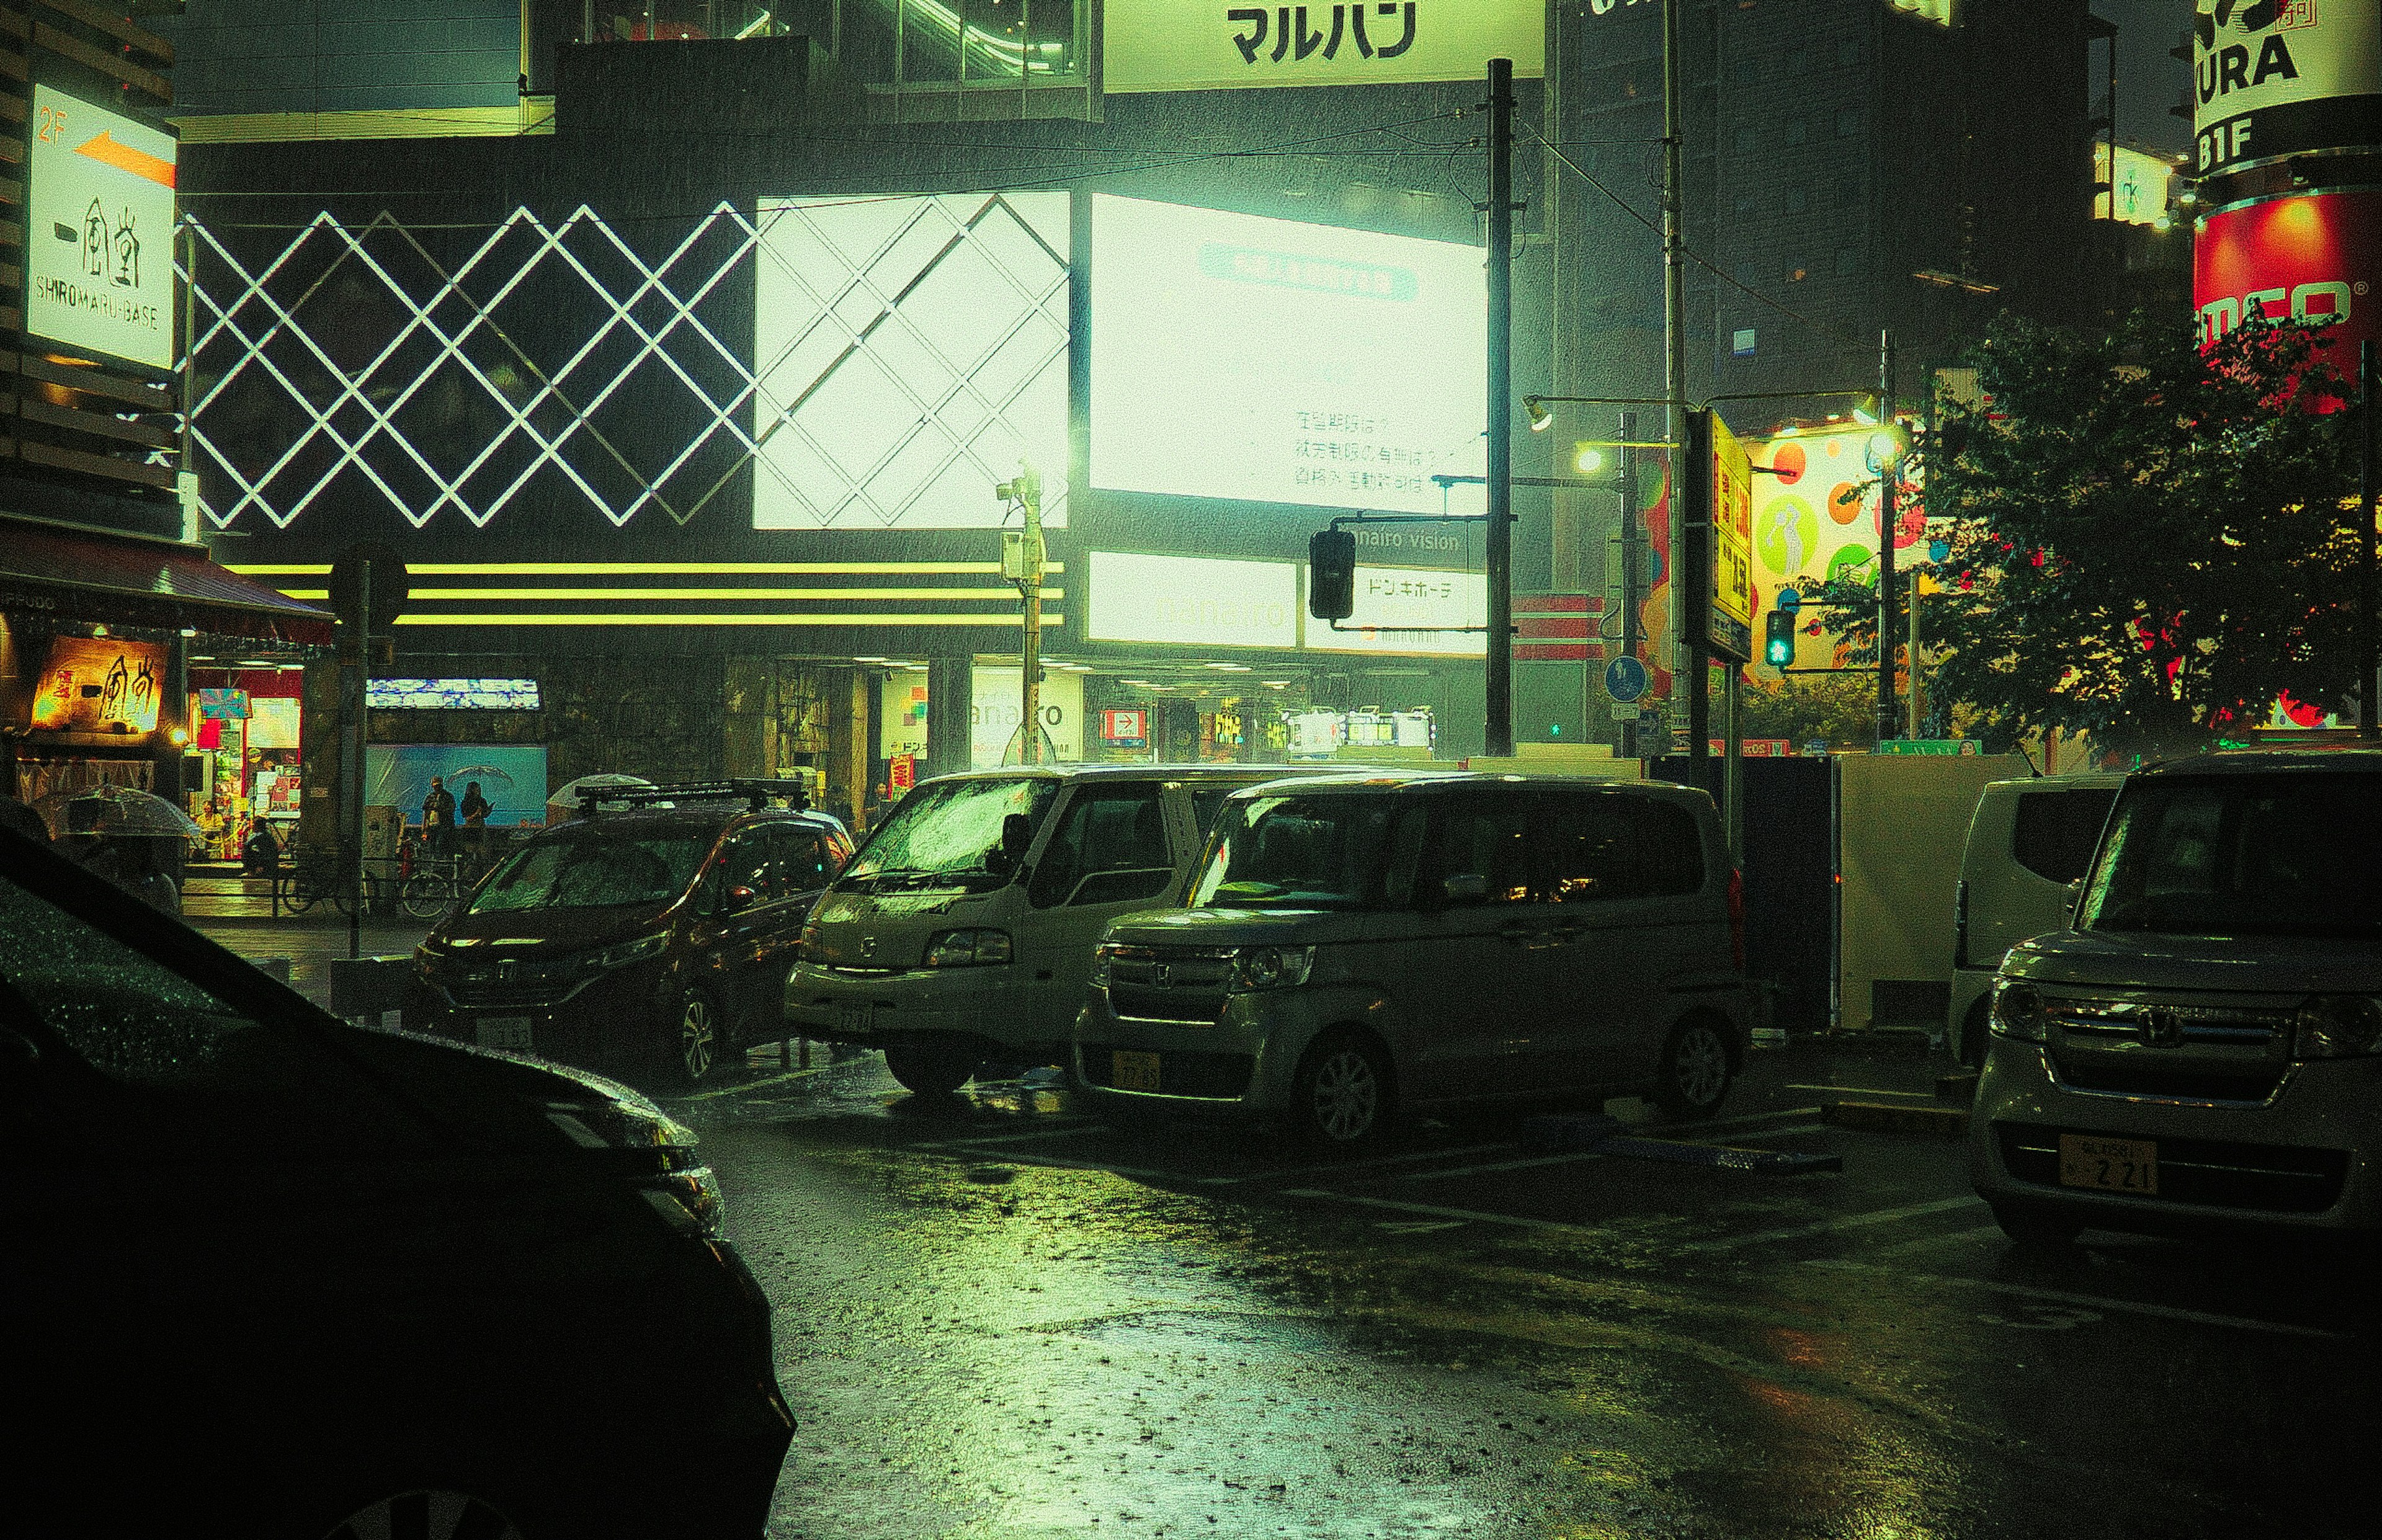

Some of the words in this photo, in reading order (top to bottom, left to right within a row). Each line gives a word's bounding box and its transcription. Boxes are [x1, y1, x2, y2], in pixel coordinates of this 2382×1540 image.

[1228, 2, 1416, 65] マルハン
[2192, 34, 2299, 110] URA
[38, 105, 68, 148] 2F
[2199, 118, 2252, 173] B1F
[35, 275, 159, 331] SHIROMARU-BASE
[2192, 281, 2351, 351] mco
[1355, 525, 1403, 546] nairo
[1410, 528, 1460, 551] vision
[1156, 591, 1284, 629] nanairo
